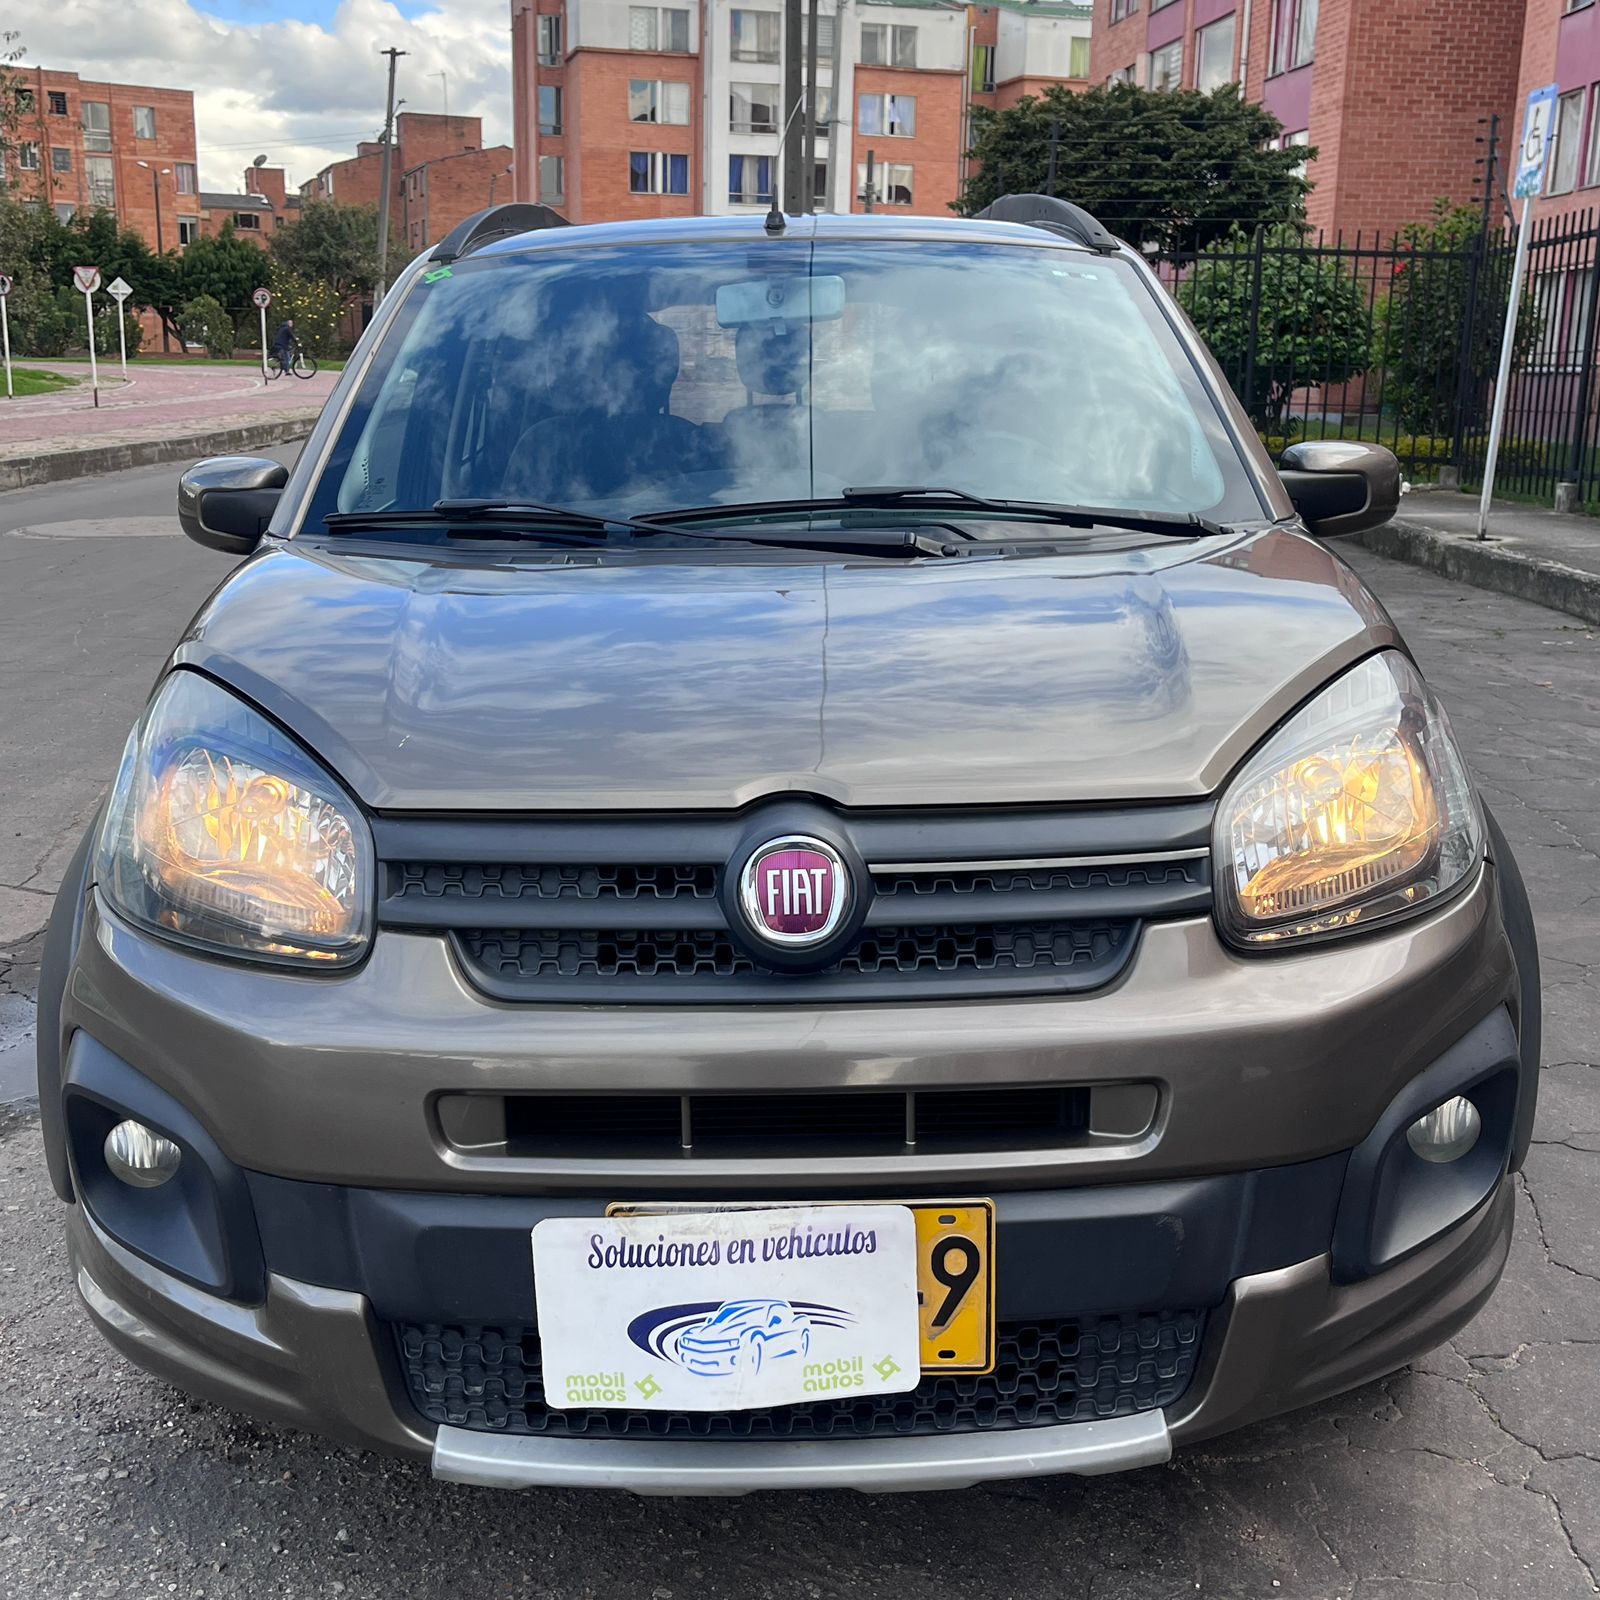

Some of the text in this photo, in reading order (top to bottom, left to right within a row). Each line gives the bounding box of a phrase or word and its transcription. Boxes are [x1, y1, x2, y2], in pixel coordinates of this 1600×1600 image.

[767, 868, 827, 916] FIAT
[588, 1223, 877, 1269] Soluciones en vehiculos
[918, 1236, 980, 1326] 9
[803, 1356, 863, 1378] mobil
[566, 1372, 625, 1388] mobil
[803, 1373, 864, 1392] autos
[566, 1387, 627, 1402] autos
